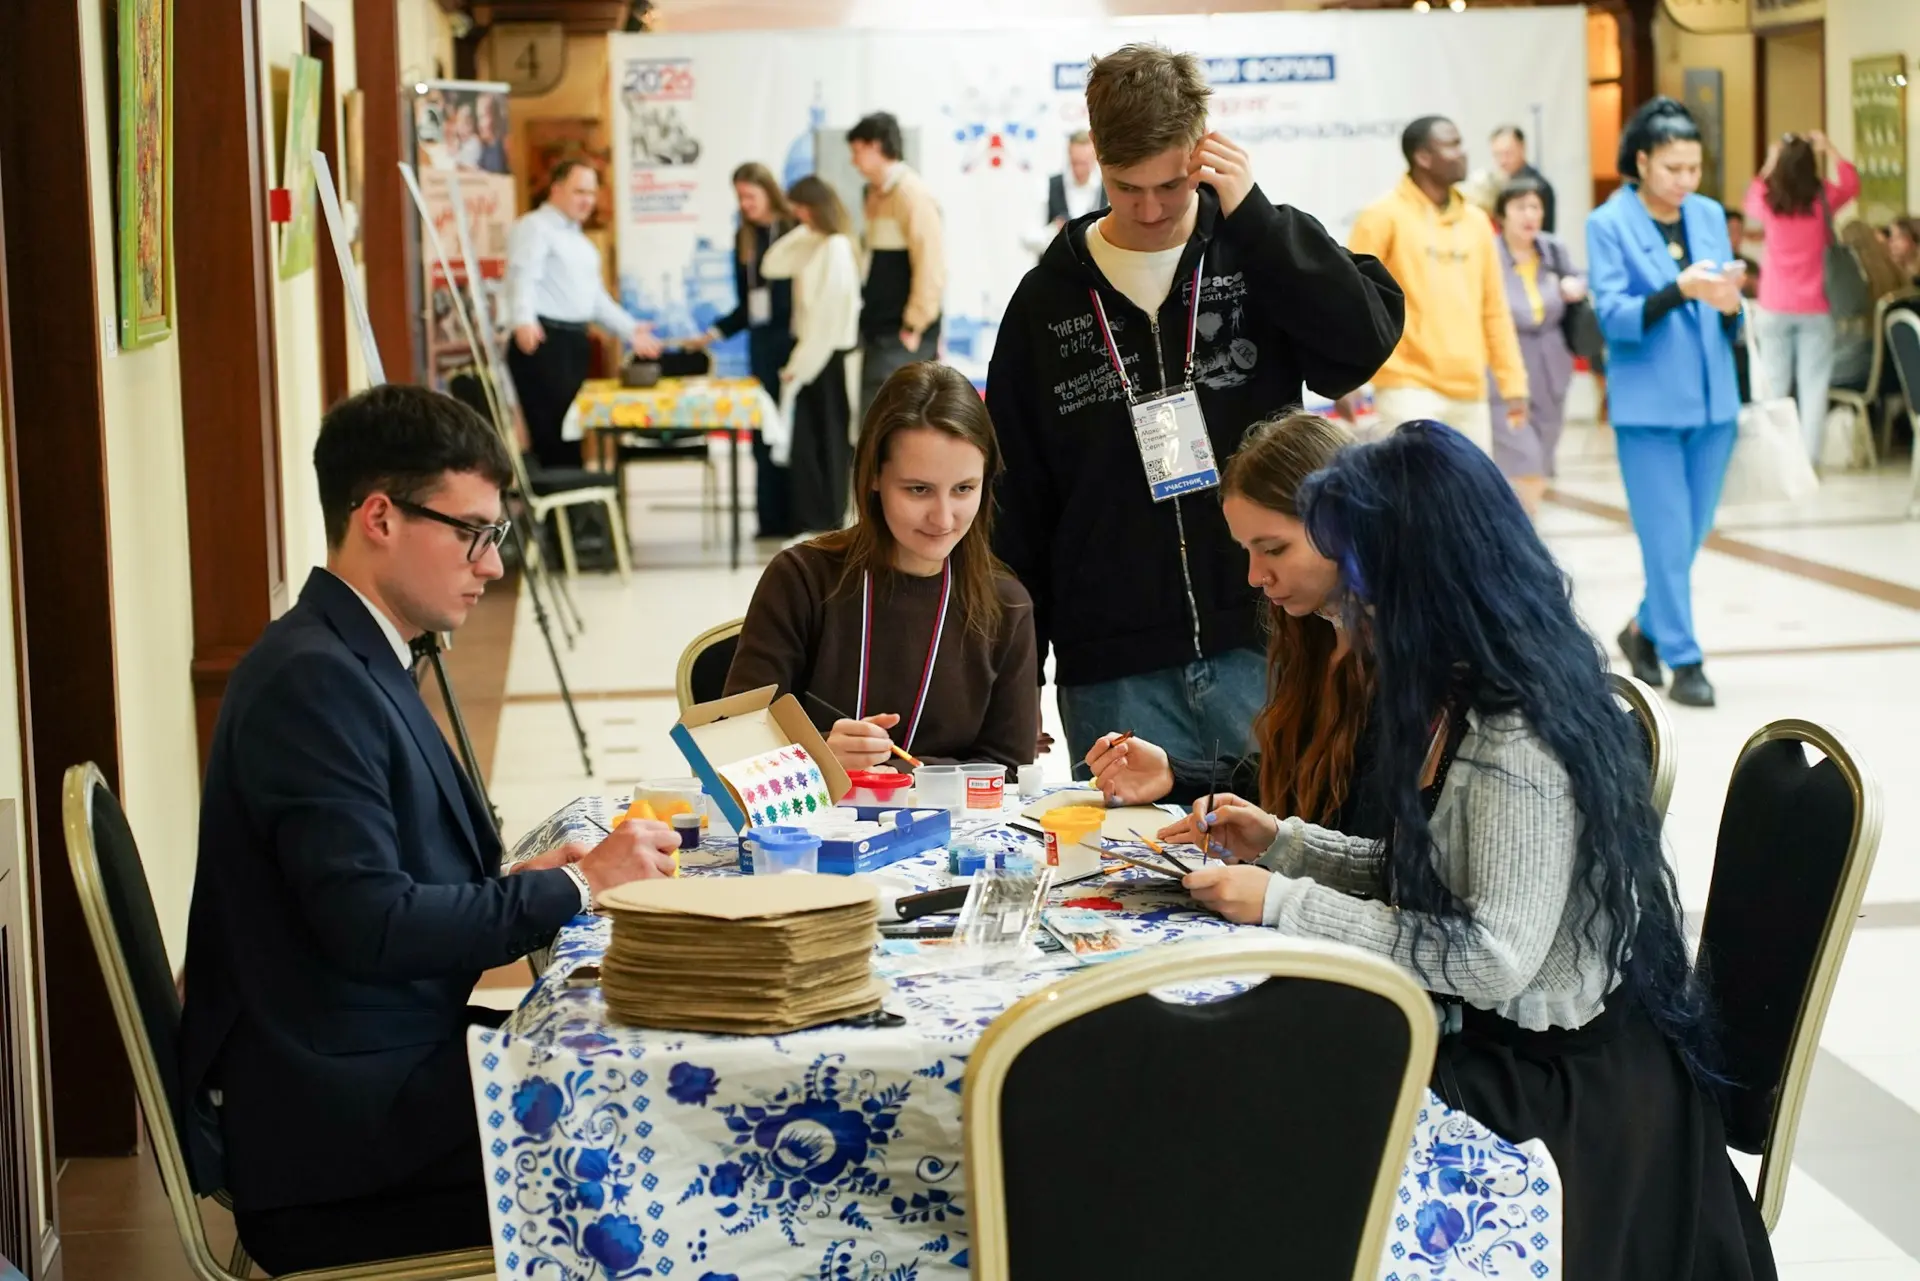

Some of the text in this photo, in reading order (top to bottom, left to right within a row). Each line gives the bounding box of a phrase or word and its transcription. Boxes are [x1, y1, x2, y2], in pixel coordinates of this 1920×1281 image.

[514, 42, 542, 80] 4
[1073, 313, 1093, 332] END
[1070, 338, 1079, 354] is
[1053, 381, 1067, 394] all
[1067, 373, 1089, 390] kids
[1089, 361, 1110, 382] just
[1061, 390, 1074, 401] to
[1093, 370, 1119, 389] peac
[1059, 392, 1097, 415] thinking
[1164, 477, 1202, 492] УЧАСТНИК
